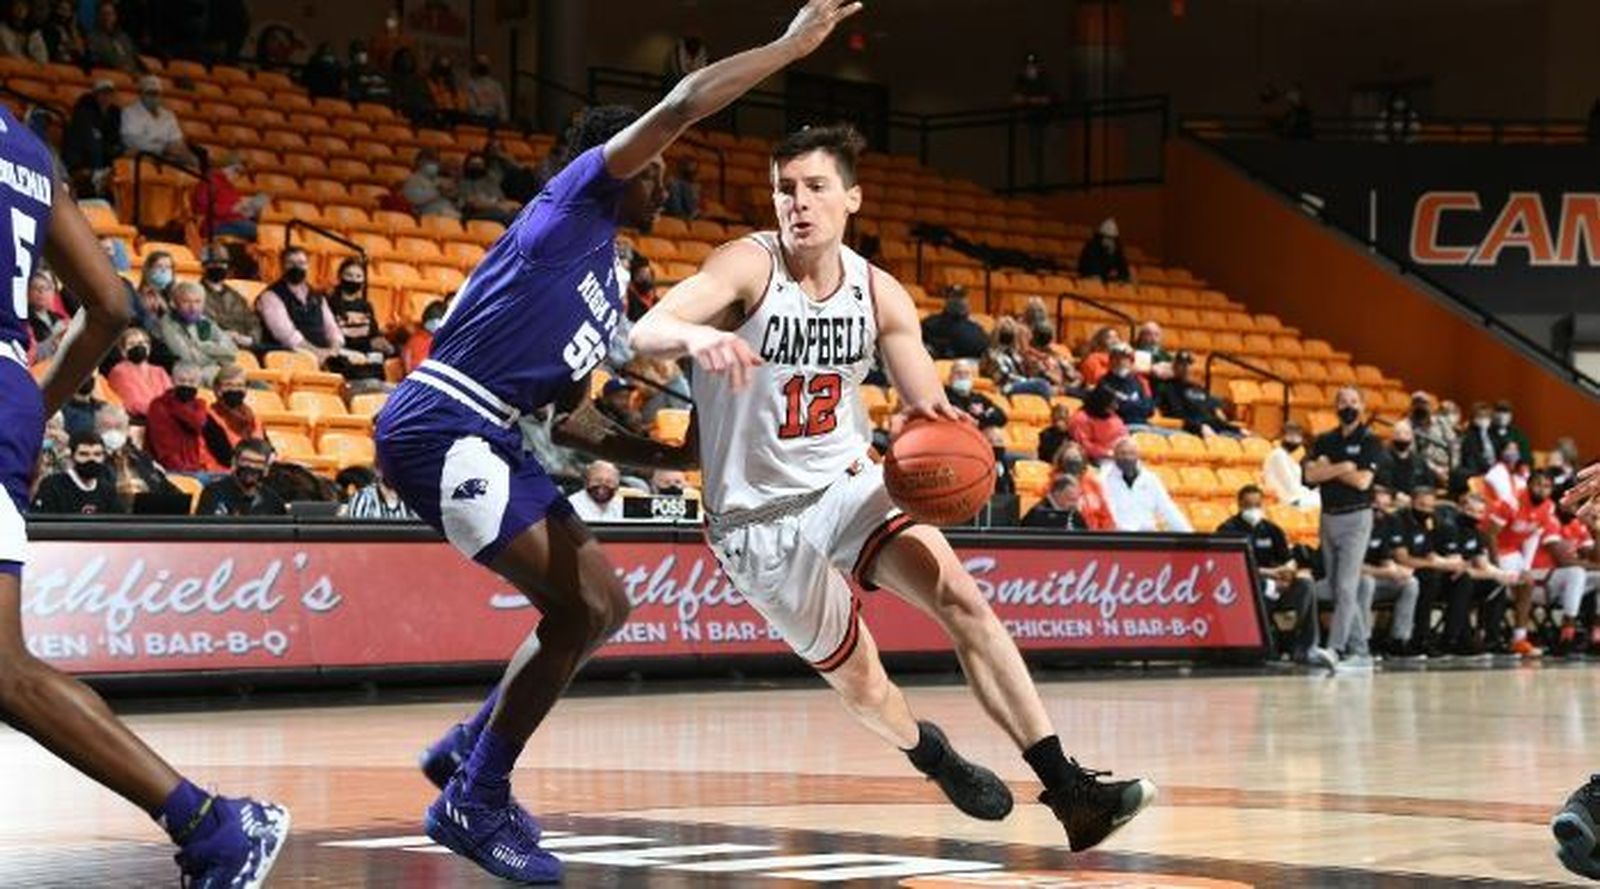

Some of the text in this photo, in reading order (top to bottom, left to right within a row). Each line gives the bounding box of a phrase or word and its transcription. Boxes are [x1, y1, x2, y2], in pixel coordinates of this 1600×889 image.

[11, 206, 37, 320] 5
[761, 314, 865, 365] CAMPBELL
[778, 373, 842, 439] 12
[964, 557, 1237, 618] Smithfield's
[145, 631, 287, 656] BAR-B-Q
[1003, 619, 1092, 637] CHICKEN
[1123, 618, 1208, 638] BAR-B-Q
